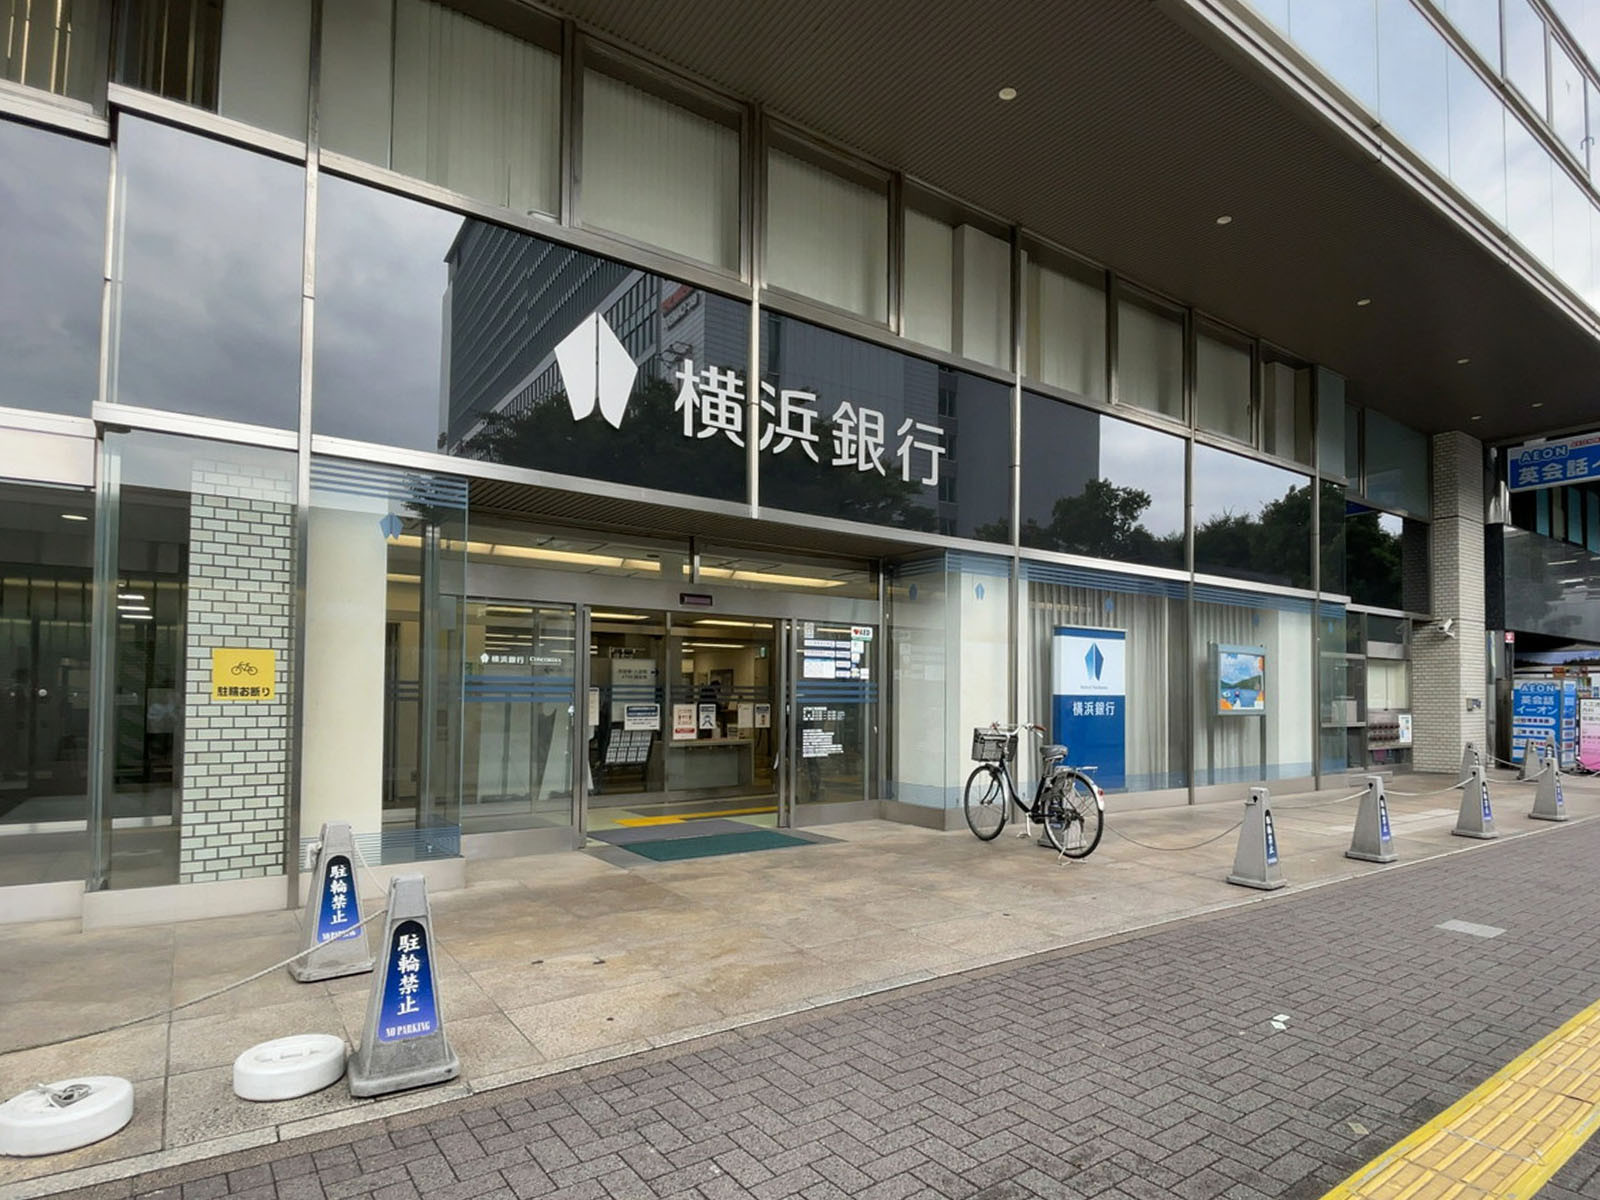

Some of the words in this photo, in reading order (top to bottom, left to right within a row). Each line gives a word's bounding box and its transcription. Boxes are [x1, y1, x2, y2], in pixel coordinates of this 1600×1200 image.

[674, 358, 946, 487] 横浜銀行
[1521, 445, 1567, 463] AEON
[1521, 684, 1555, 693] AEON
[1073, 702, 1115, 716] 横浜銀行
[1516, 706, 1558, 715] イーオン
[330, 864, 348, 925] 駐輪禁止
[397, 933, 421, 1015] 駐輪禁止
[386, 1027, 396, 1037] NO
[397, 1021, 431, 1036] PARKING
